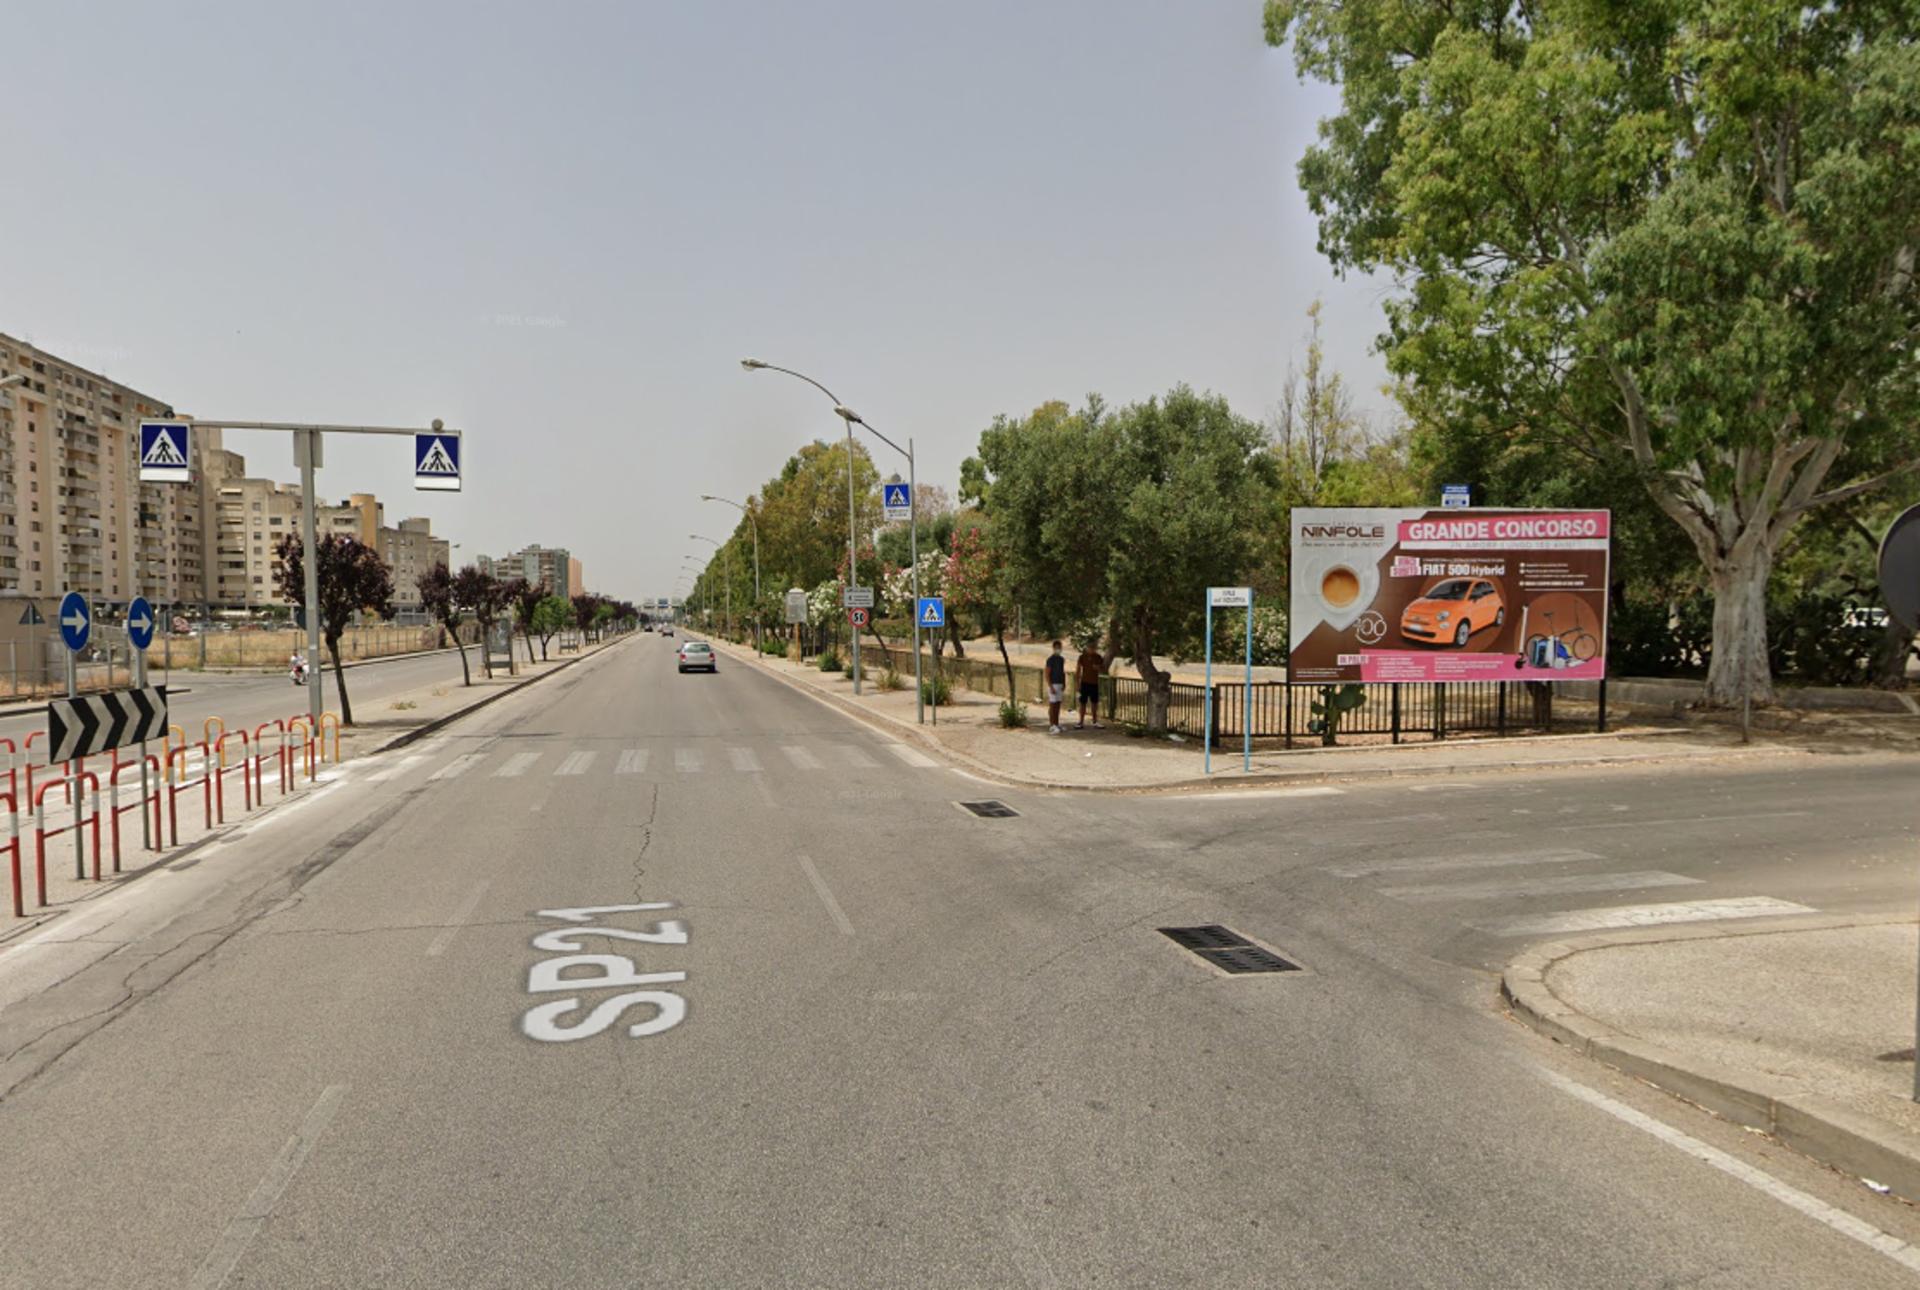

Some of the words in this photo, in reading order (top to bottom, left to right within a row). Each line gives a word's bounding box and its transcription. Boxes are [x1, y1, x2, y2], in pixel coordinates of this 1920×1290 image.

[1301, 526, 1385, 538] NINFOLE
[1408, 520, 1490, 540] GRANDE
[1494, 518, 1597, 538] CONCORSO
[1422, 563, 1446, 576] FIAT
[1448, 563, 1470, 576] 500
[1471, 564, 1505, 578] Hybrid
[522, 901, 688, 1042] SP21
